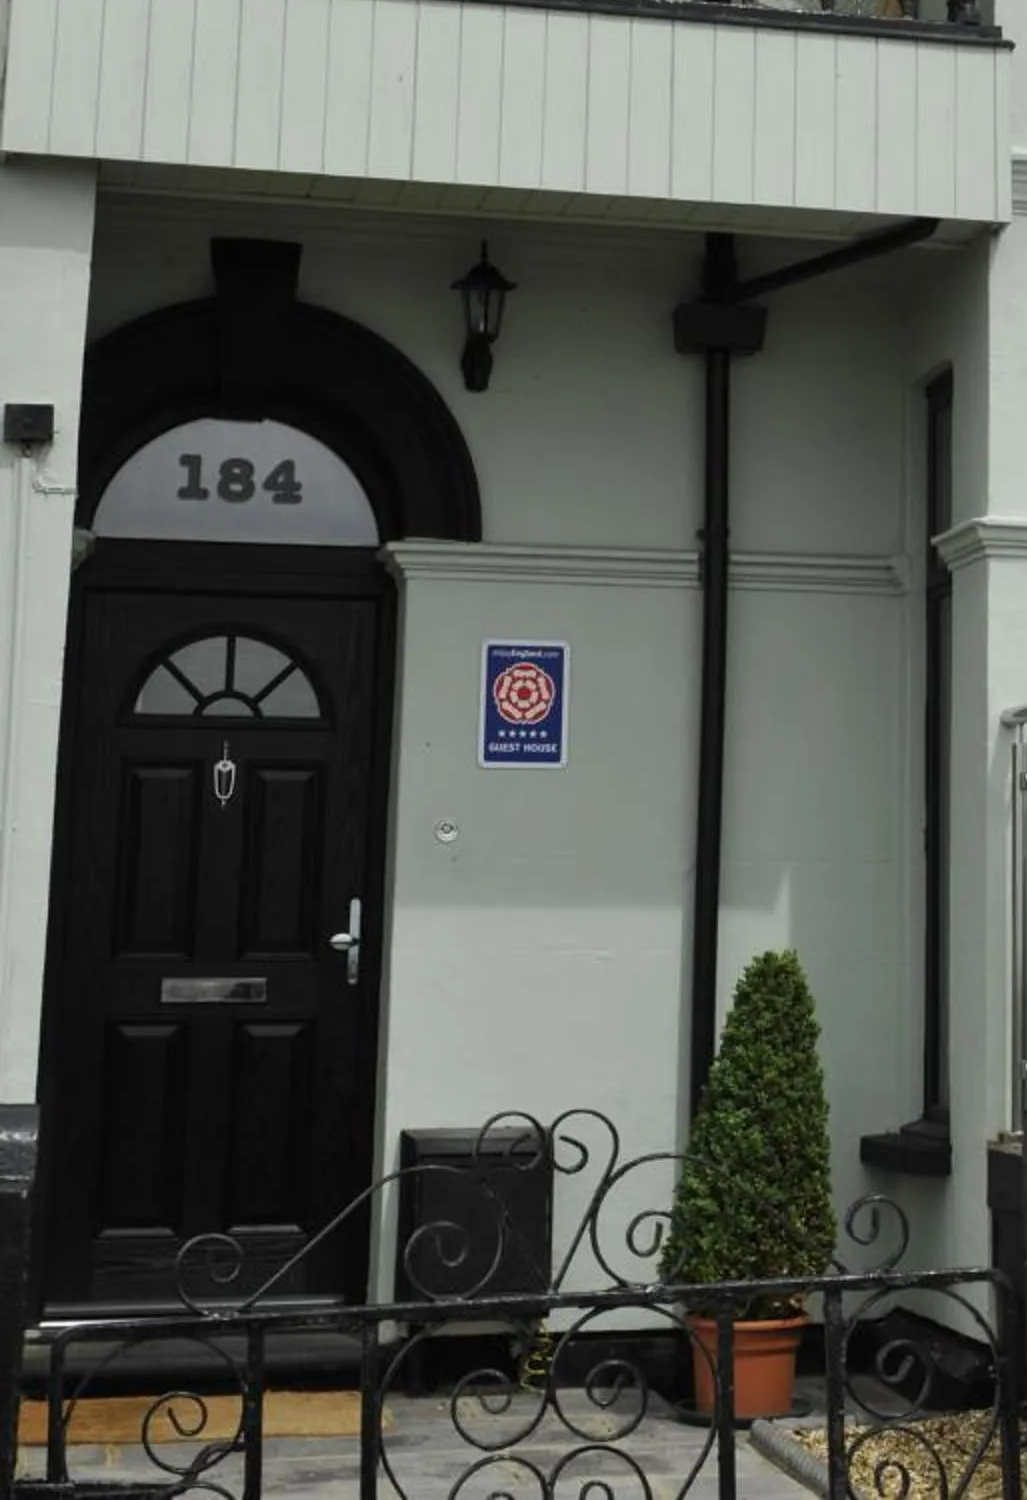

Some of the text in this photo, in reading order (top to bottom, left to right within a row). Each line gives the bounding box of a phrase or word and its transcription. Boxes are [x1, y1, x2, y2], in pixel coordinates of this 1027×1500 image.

[177, 453, 303, 505] 184
[487, 742, 558, 753] GUEST HOUSE
